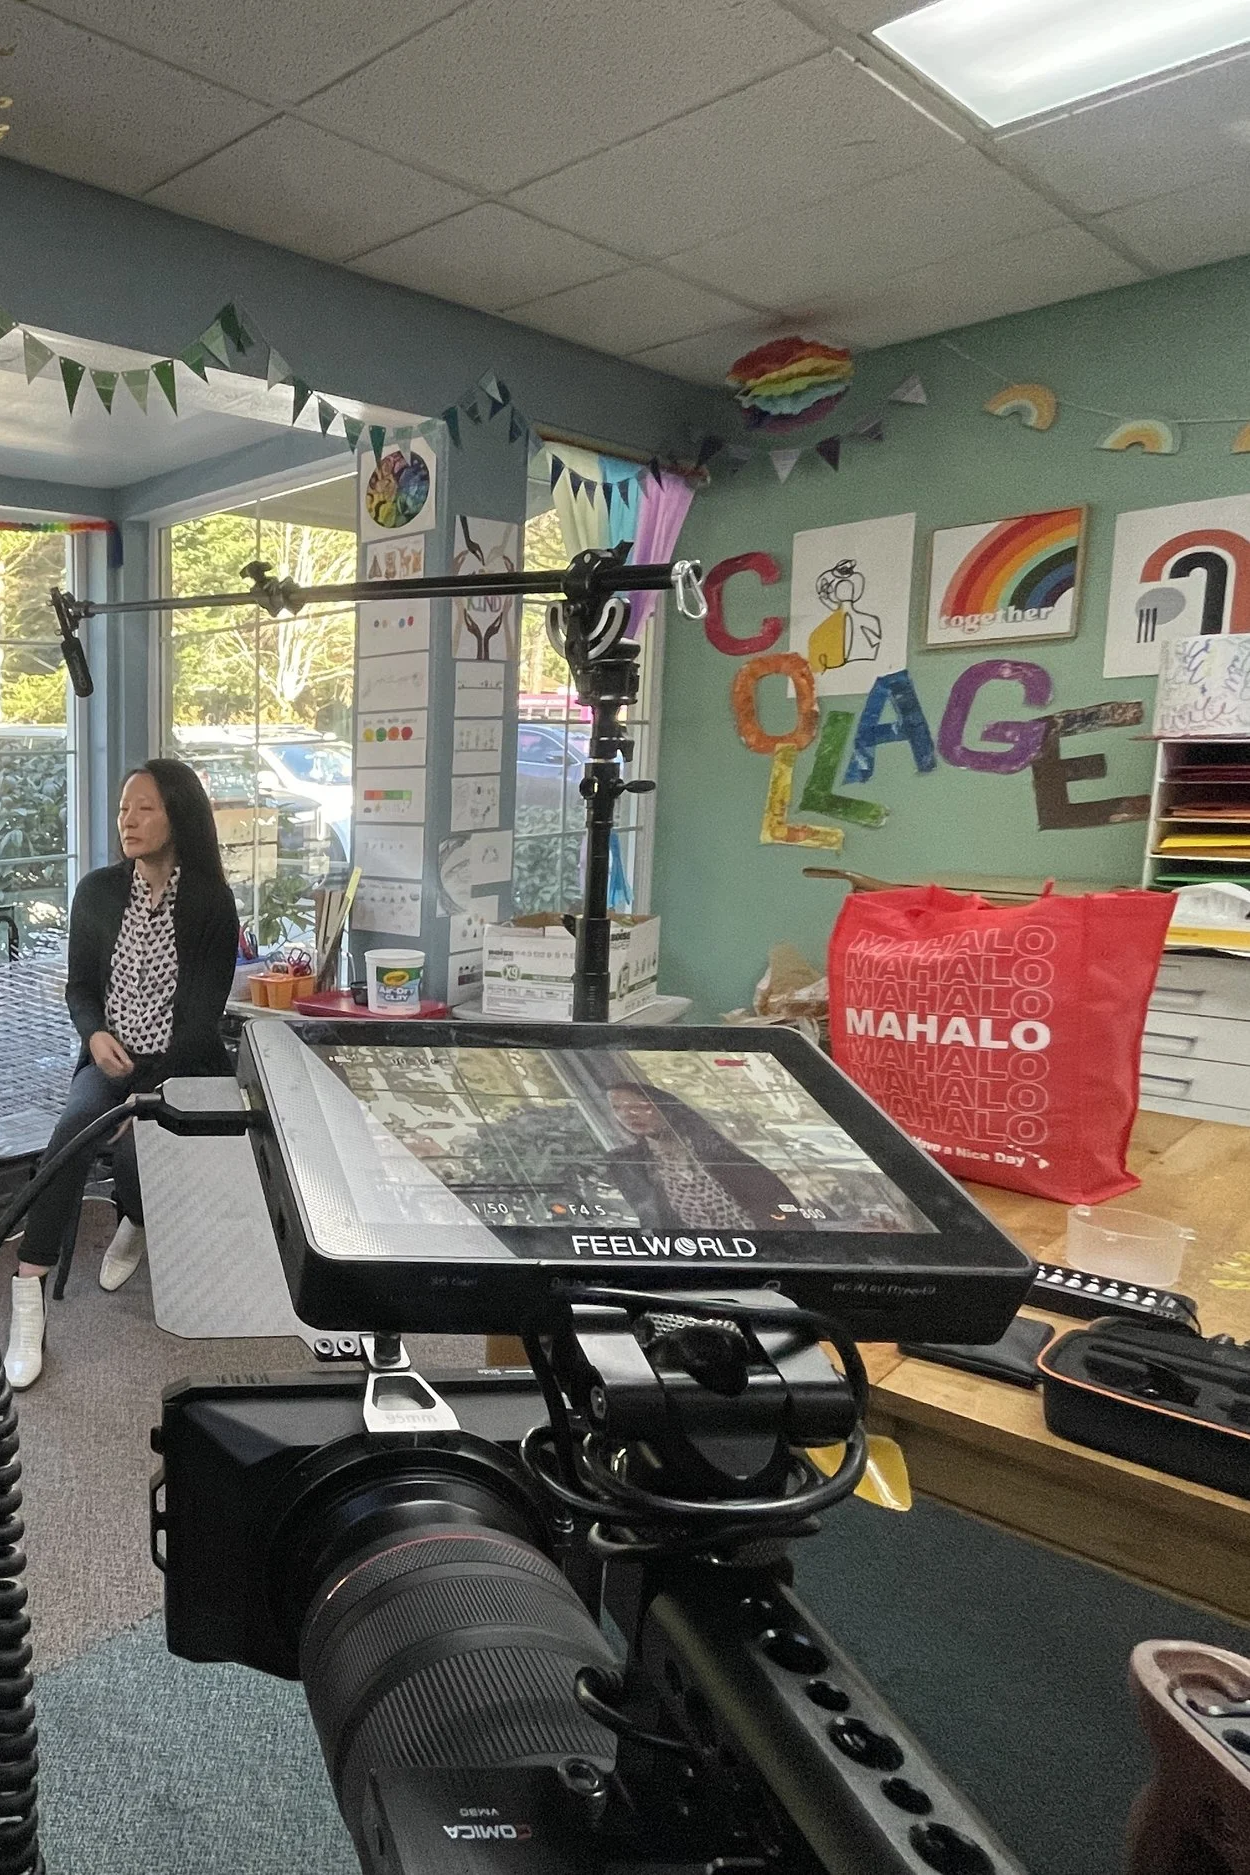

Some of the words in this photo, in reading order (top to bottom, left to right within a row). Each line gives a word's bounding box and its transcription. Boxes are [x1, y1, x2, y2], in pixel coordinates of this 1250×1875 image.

[939, 605, 1054, 634] together
[849, 925, 1056, 957] MAHALO
[505, 966, 519, 979] X9
[845, 951, 1054, 989] MAHALO
[845, 979, 1053, 1020] MAHALO
[845, 1007, 1051, 1051] MAHALO
[847, 1034, 1050, 1082] MAHALO
[943, 1146, 952, 1155] a
[956, 1147, 990, 1161] Nice
[994, 1152, 1026, 1168] Day
[472, 1202, 509, 1214] 1/50
[571, 1235, 757, 1257] FEELWORLD
[385, 1413, 437, 1425] 95mm
[443, 1824, 532, 1840] COMICA
